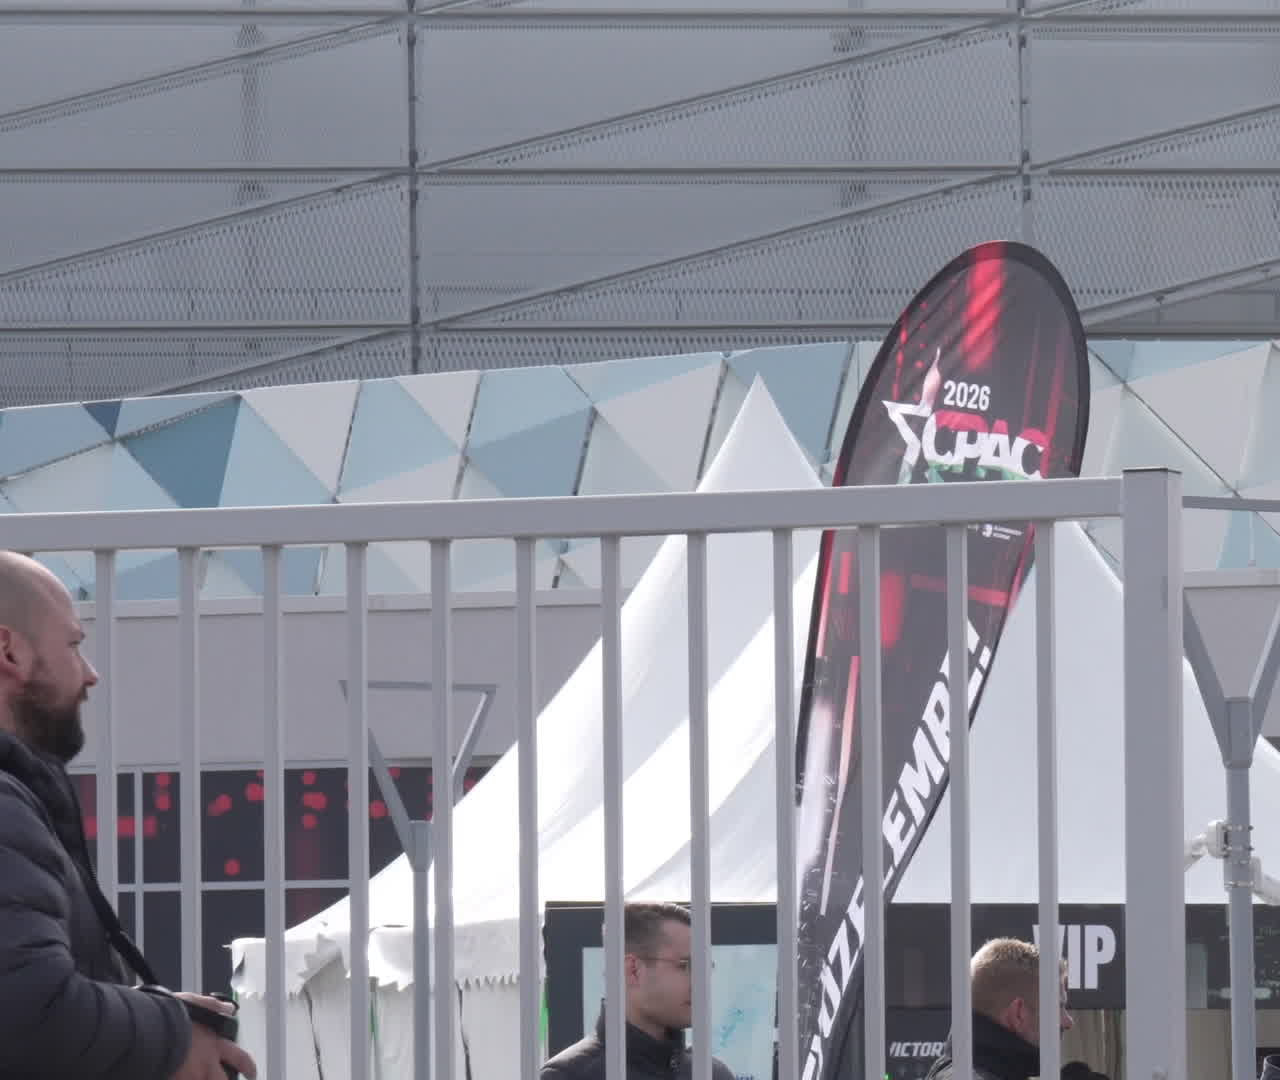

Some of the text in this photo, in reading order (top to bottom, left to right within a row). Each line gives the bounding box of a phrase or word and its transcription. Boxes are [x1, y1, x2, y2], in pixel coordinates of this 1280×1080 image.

[943, 380, 991, 411] 2026
[921, 410, 1051, 481] CPAC
[1033, 924, 1116, 989] IP
[889, 1042, 946, 1057] VICTOR
